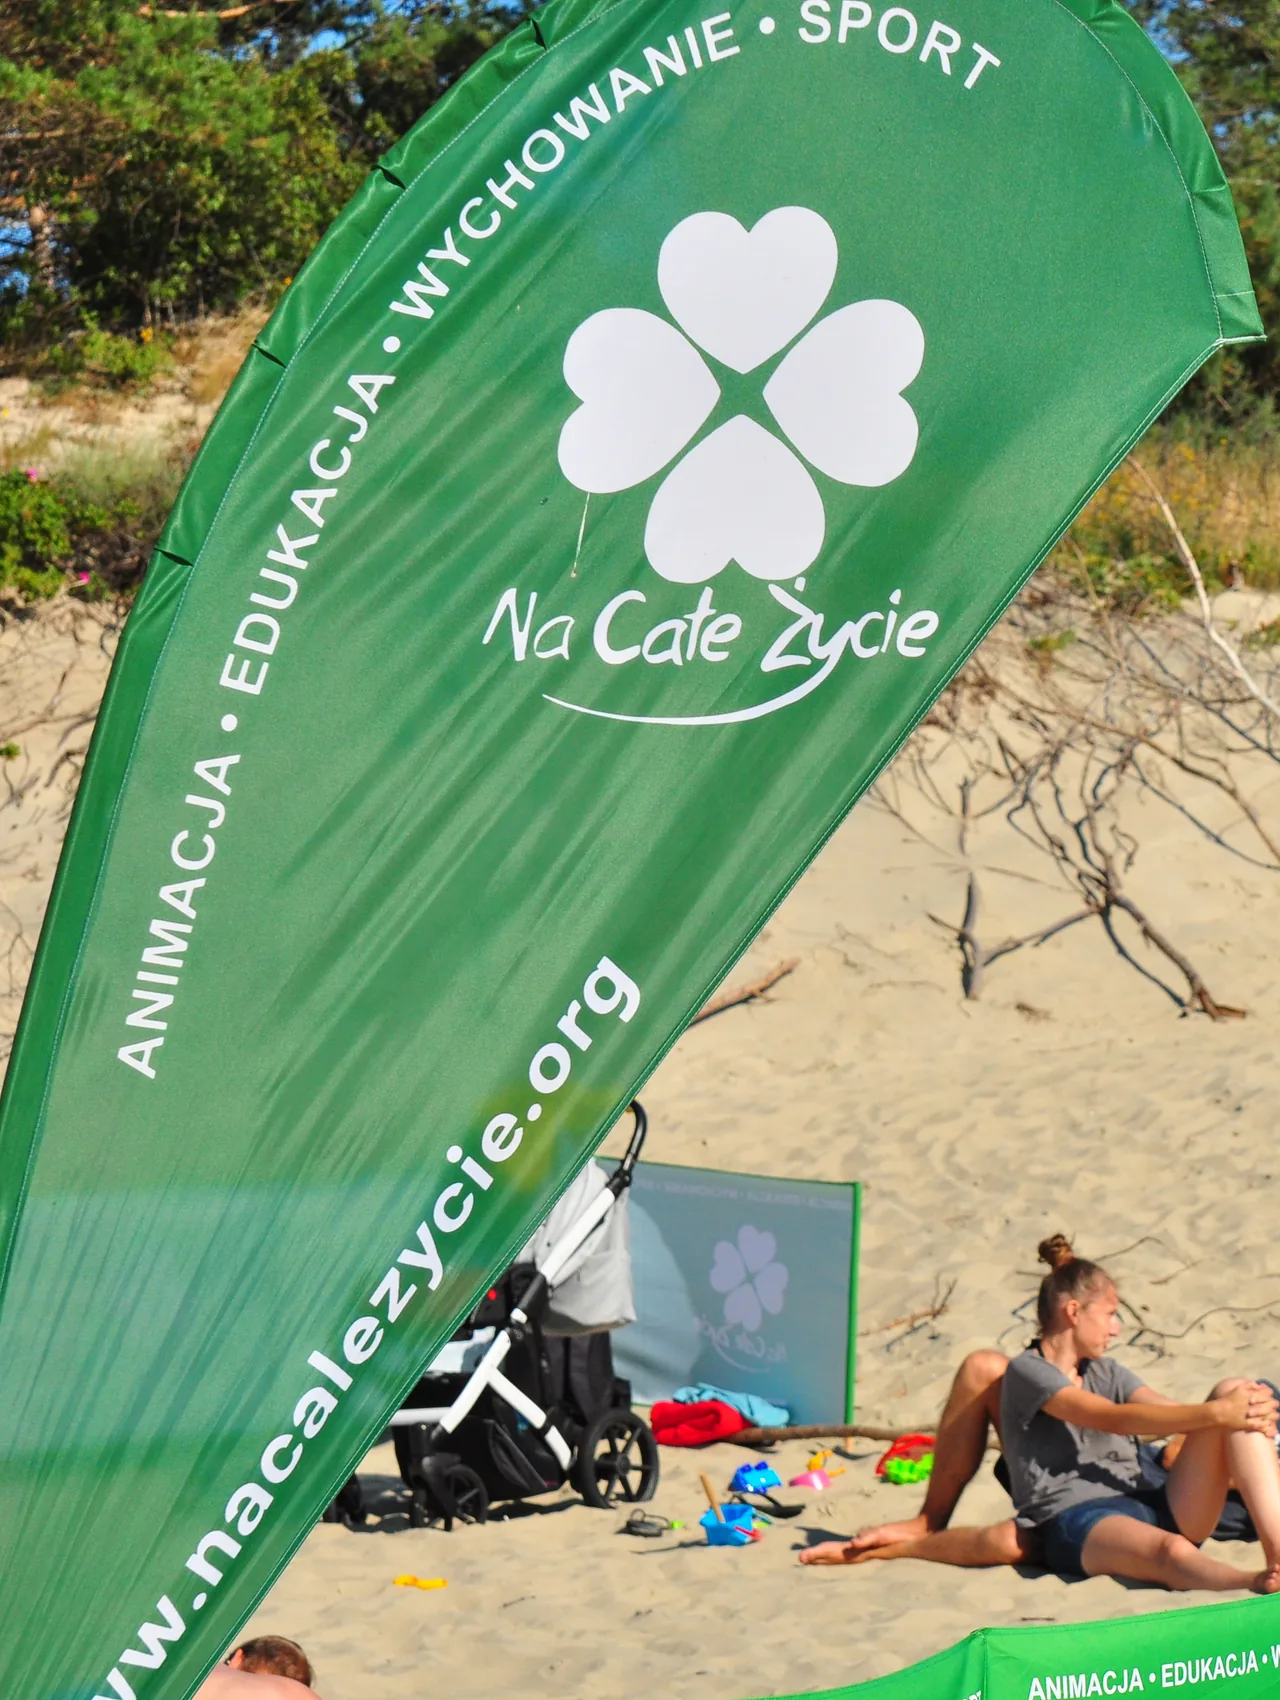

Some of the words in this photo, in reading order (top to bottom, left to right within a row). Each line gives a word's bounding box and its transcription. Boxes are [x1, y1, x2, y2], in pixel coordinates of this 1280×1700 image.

[116, 753, 242, 1080] ANIMACJA
[218, 373, 397, 697] EDUKACJA
[389, 11, 741, 322] WYCHOWANIE
[797, 0, 1002, 90] SPORT
[482, 586, 576, 662] Na
[91, 955, 642, 1700] w.nacalezycie.org
[1028, 1667, 1145, 1700] ANIMACJA
[1161, 1649, 1259, 1688] EDUKACJA
